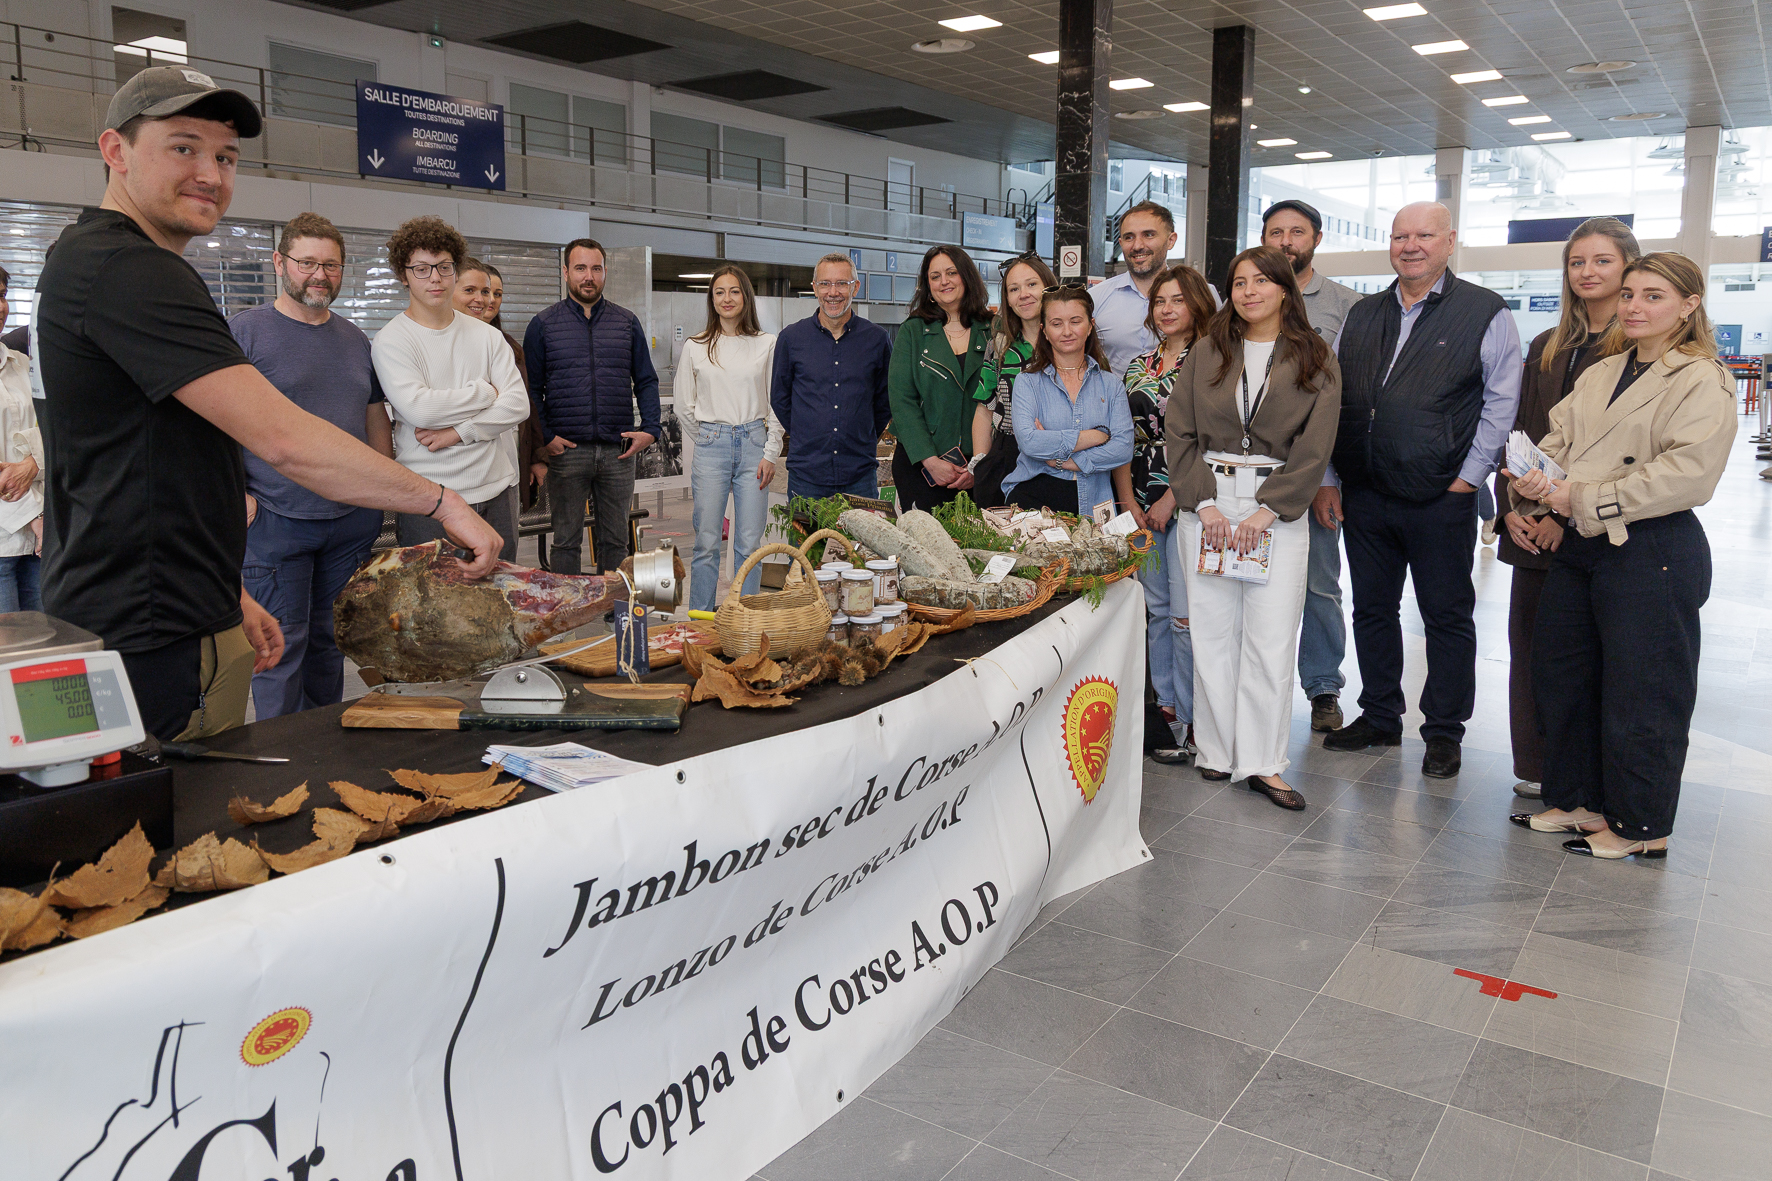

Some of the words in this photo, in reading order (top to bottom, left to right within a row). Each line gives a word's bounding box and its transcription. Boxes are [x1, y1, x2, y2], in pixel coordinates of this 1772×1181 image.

[364, 87, 400, 106] SALLE
[402, 94, 498, 122] D'EMBARQUEMENT
[404, 110, 427, 121] TOUTES
[427, 113, 465, 127] DESTINATIONS
[412, 127, 458, 144] BOARDING
[424, 141, 457, 152] DESTINATIONS
[416, 155, 456, 170] IMBARCU
[427, 168, 460, 179] DESTINAZIONE
[854, 253, 858, 266] 1
[890, 256, 895, 269] 2
[982, 266, 986, 276] 4
[96, 689, 112, 697] €/kg
[1078, 687, 1116, 706] D'ORIGINE
[68, 703, 93, 719] 0.00
[1070, 703, 1089, 783] APPELLATION
[543, 840, 771, 958] Jambon
[773, 806, 842, 858] sec
[844, 774, 889, 827] de
[893, 743, 978, 802] Corse
[581, 934, 737, 1030] Lonzo
[743, 899, 794, 948] de
[800, 846, 891, 917] Corse
[887, 785, 970, 862] A.O.P
[590, 1051, 734, 1174] Coppa
[741, 1005, 791, 1071] de
[794, 947, 906, 1032] Corse
[911, 881, 999, 972] A.O.P
